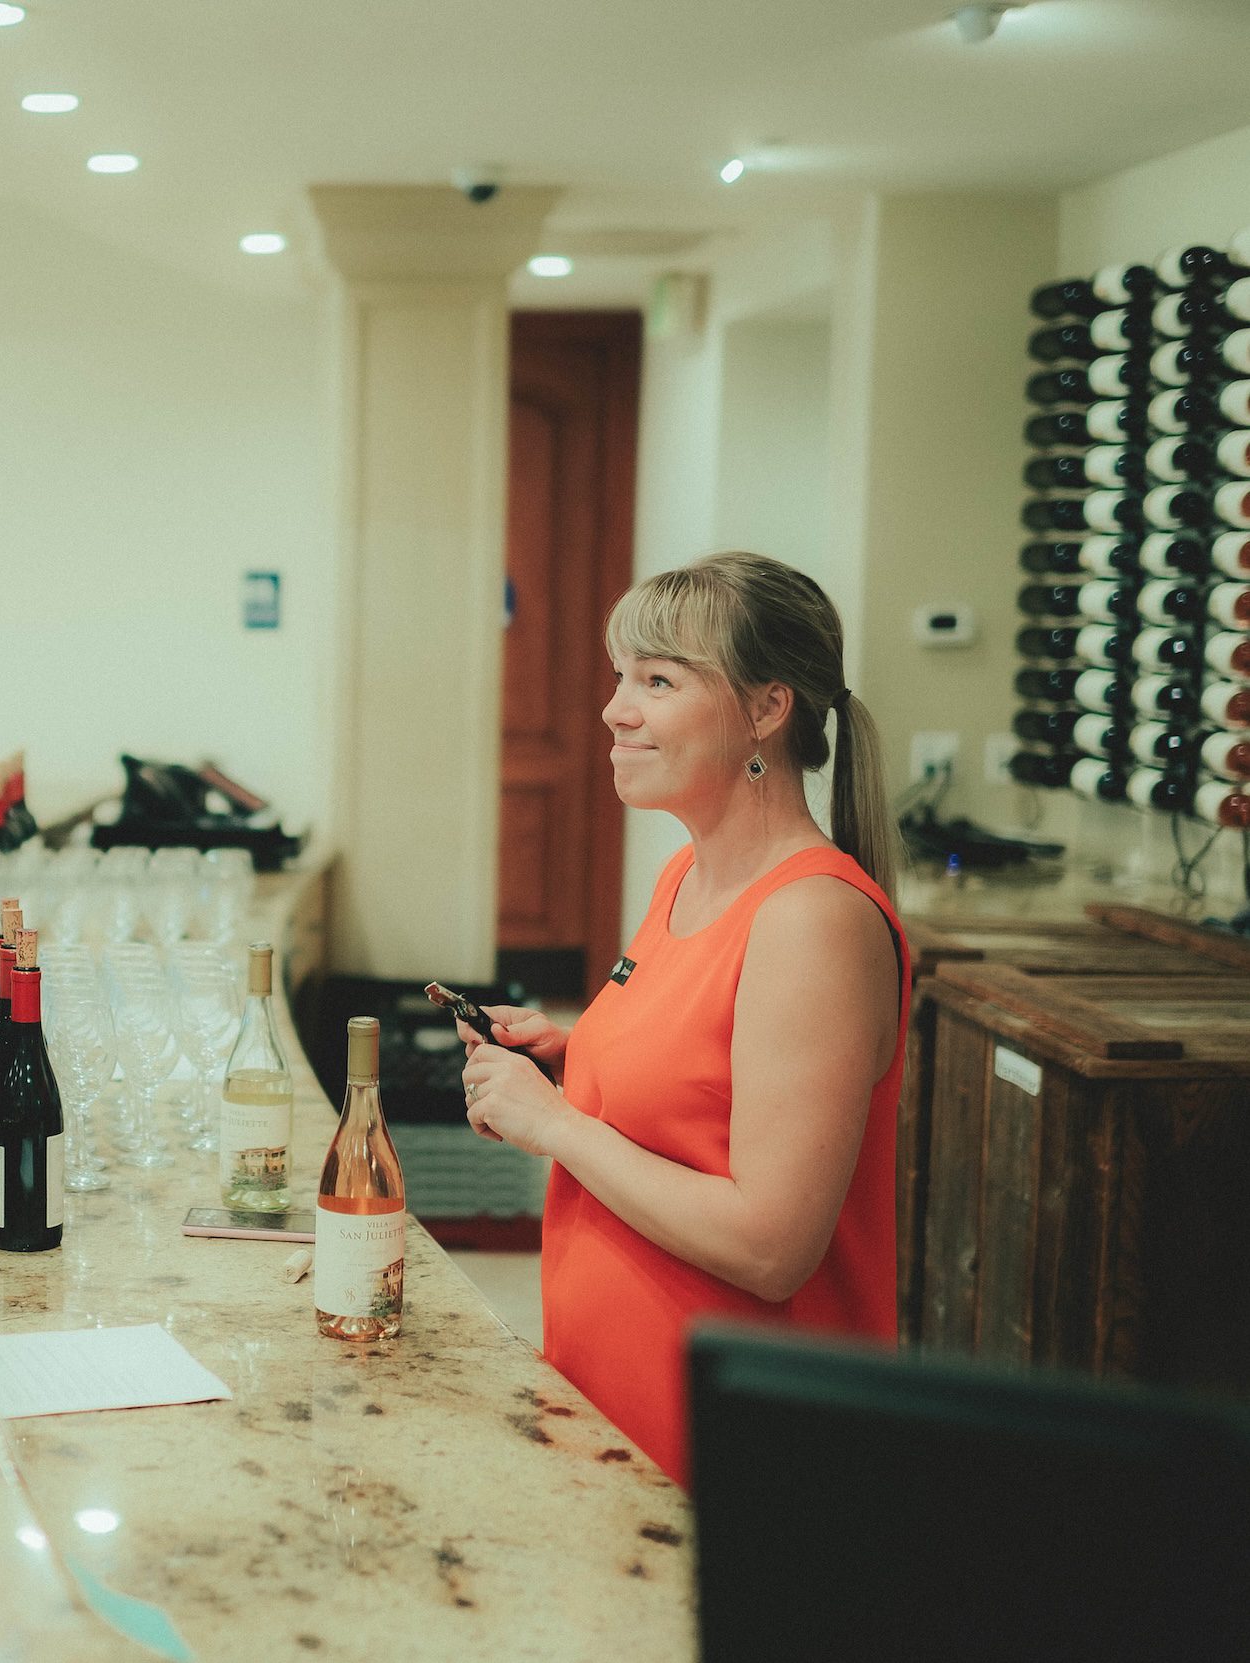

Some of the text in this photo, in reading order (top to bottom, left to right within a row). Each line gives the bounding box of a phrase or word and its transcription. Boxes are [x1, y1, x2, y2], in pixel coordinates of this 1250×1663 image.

[367, 1221, 389, 1229] VILLA
[339, 1226, 404, 1242] SAN JULIETTE
